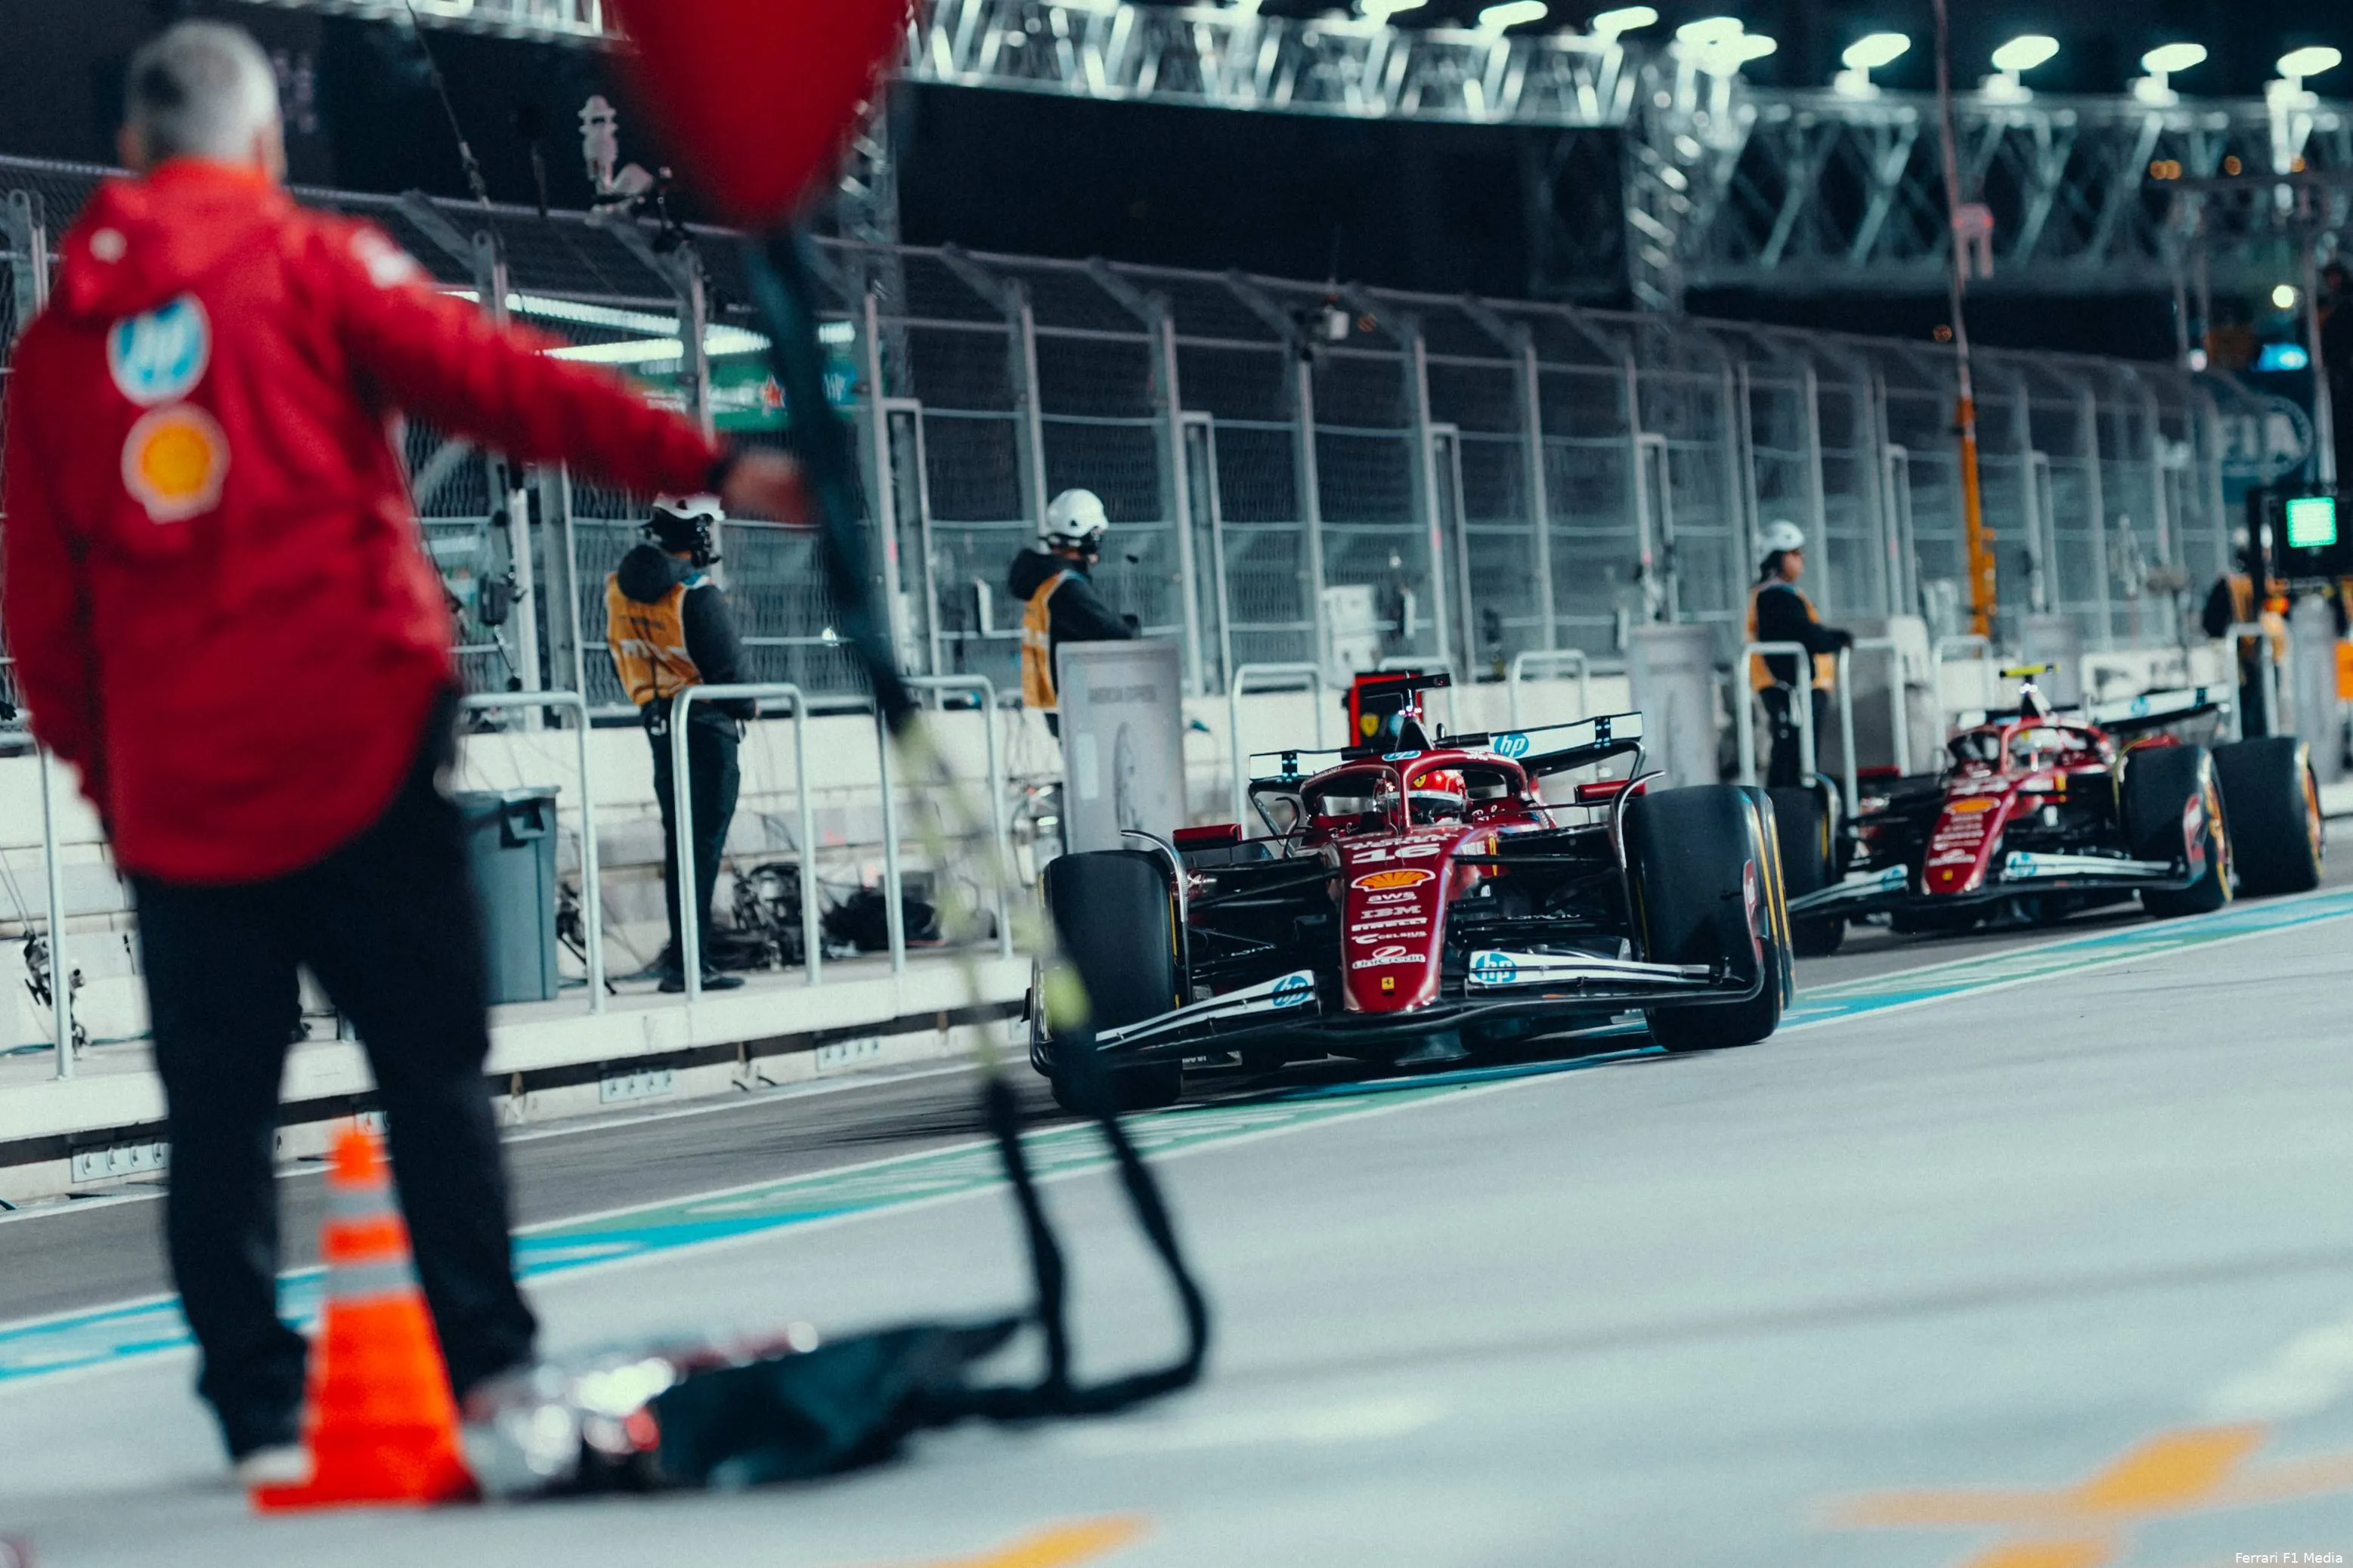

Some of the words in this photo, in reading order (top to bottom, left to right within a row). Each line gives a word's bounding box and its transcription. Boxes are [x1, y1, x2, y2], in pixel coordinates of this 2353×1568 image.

[1497, 733, 1528, 759] hp
[1351, 843, 1441, 864] 16
[1367, 892, 1416, 904] aws
[1361, 905, 1422, 920] IBM
[1478, 953, 1516, 983] hp
[1274, 976, 1308, 1007] hp
